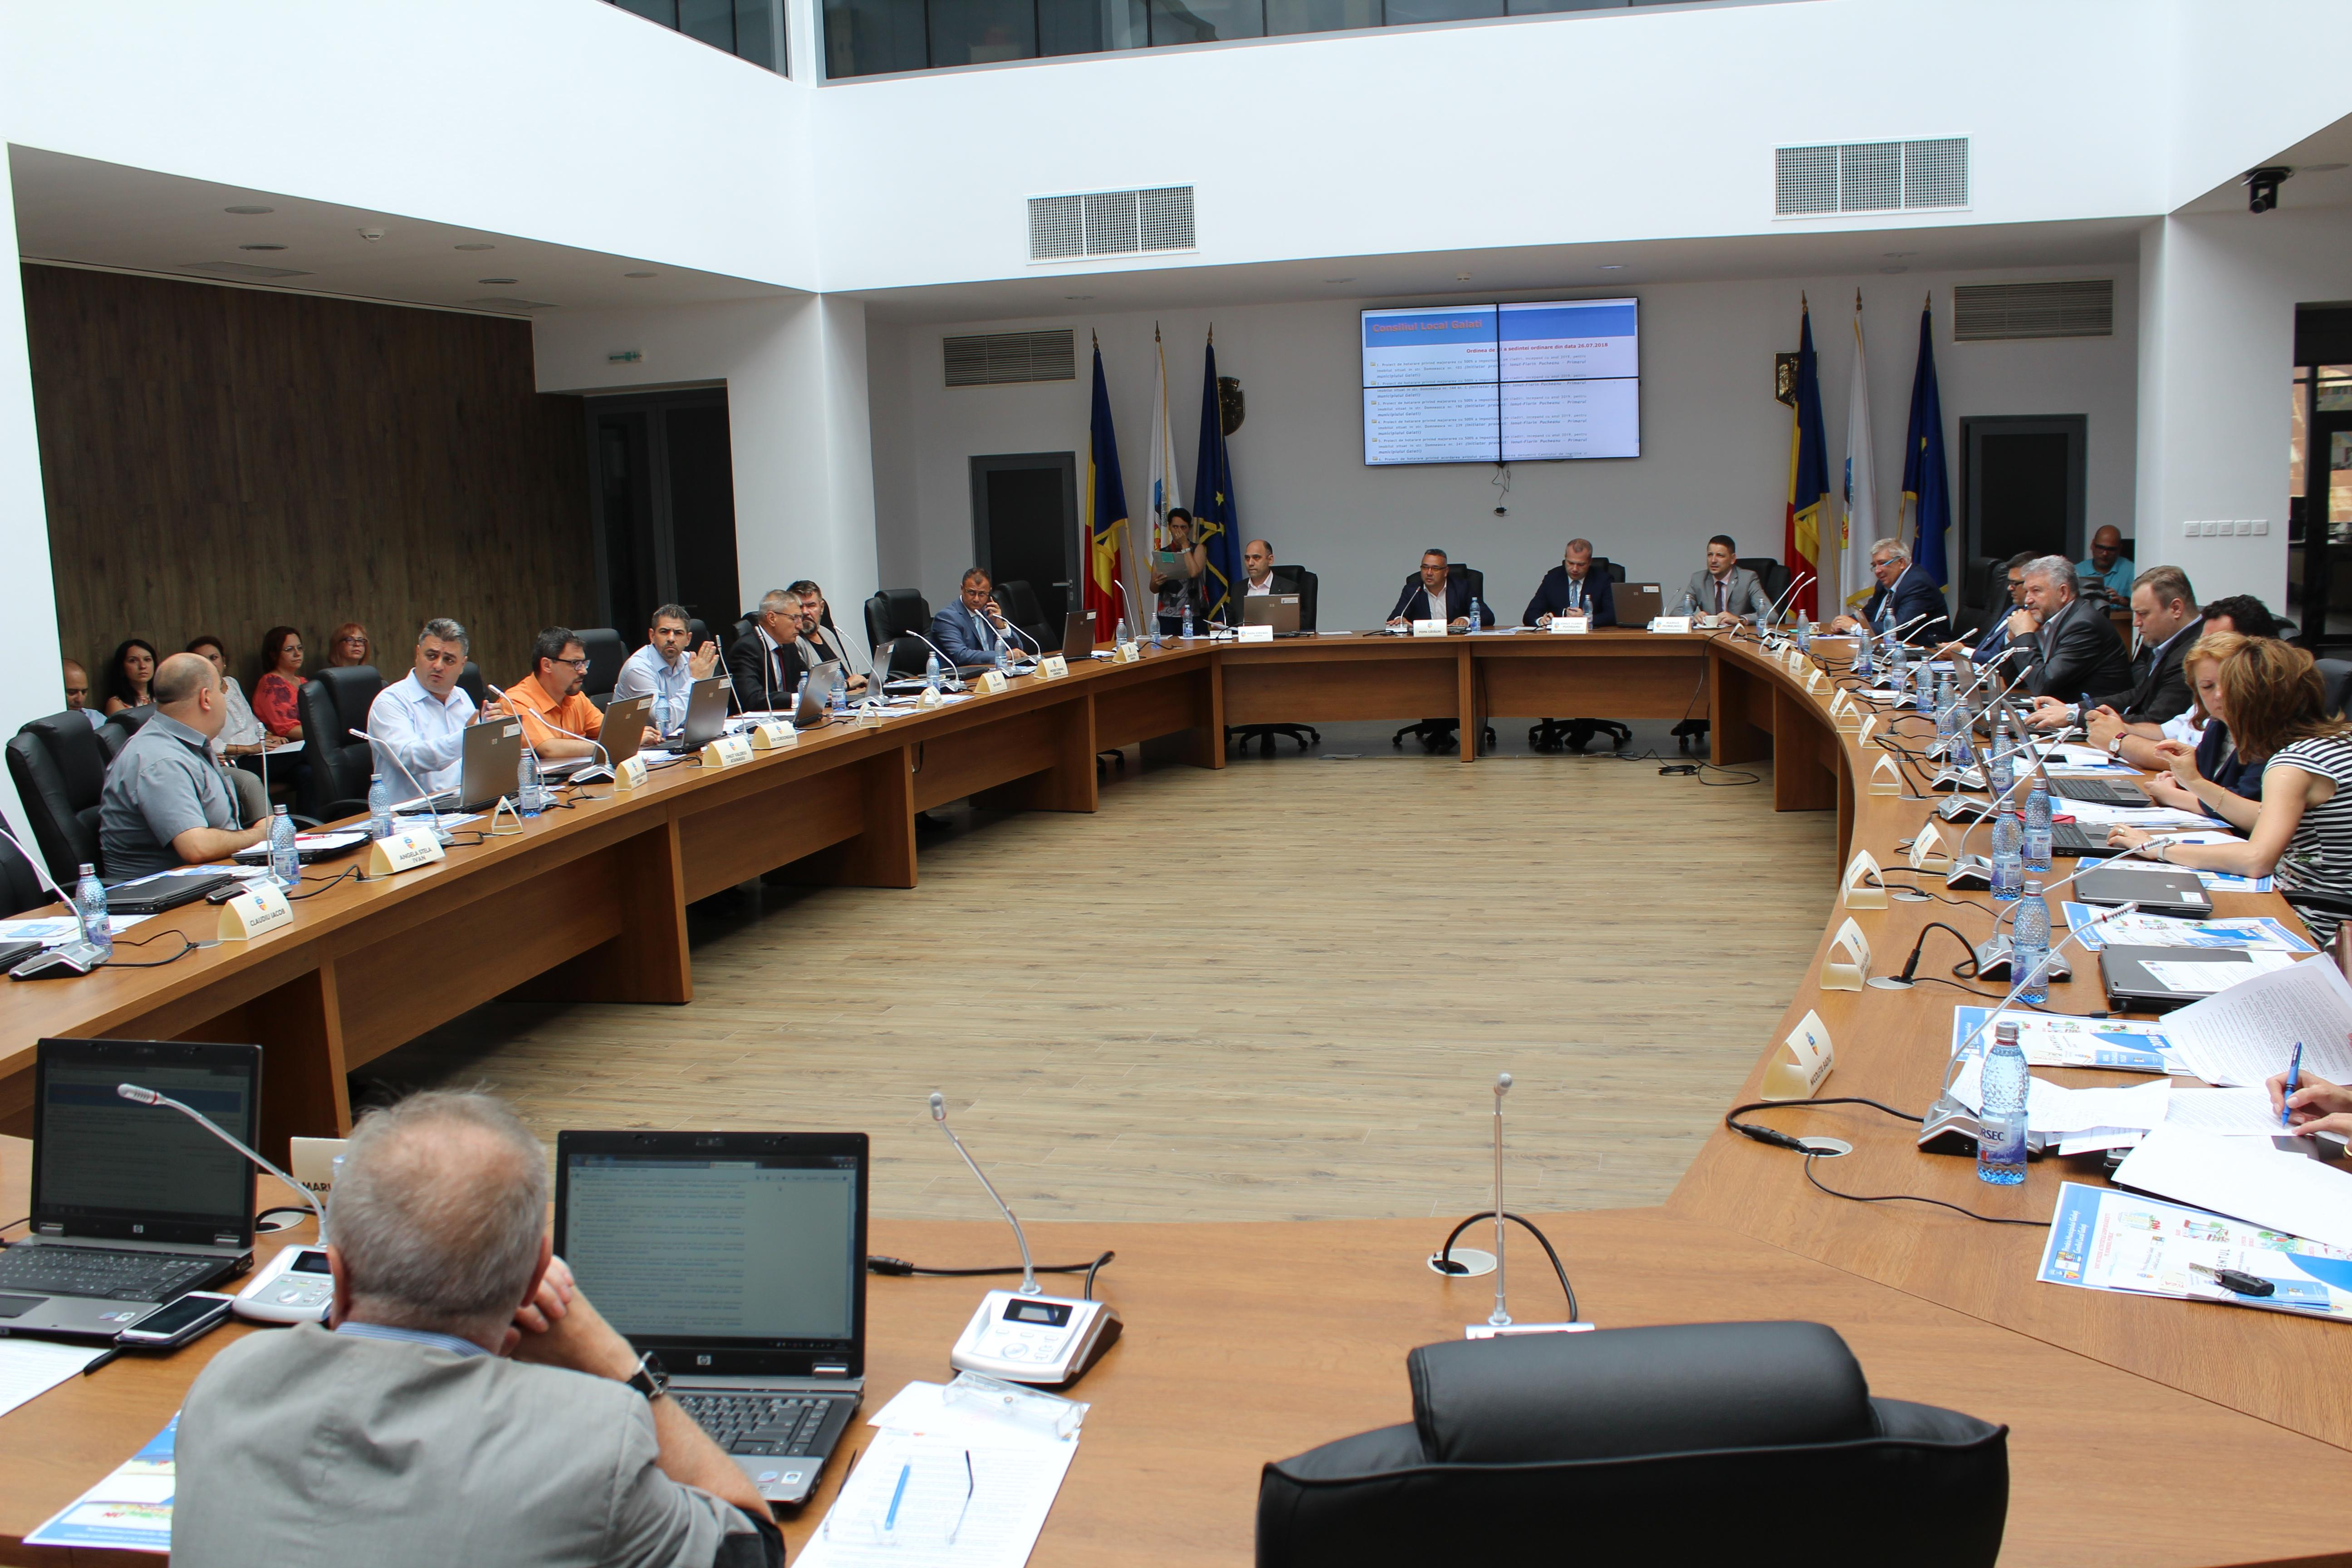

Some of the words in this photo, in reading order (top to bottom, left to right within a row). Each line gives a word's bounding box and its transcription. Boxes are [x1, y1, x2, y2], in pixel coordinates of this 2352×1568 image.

[1372, 322, 1418, 333] Consiliul
[1421, 320, 1448, 331] Local
[1451, 319, 1483, 330] Galati
[399, 851, 418, 861] ANGELA
[418, 847, 432, 857] STELA
[412, 855, 427, 863] IVAN
[250, 912, 271, 927] CLAUDIU
[271, 908, 286, 922] IACOB
[2146, 1035, 2166, 1047] 2018
